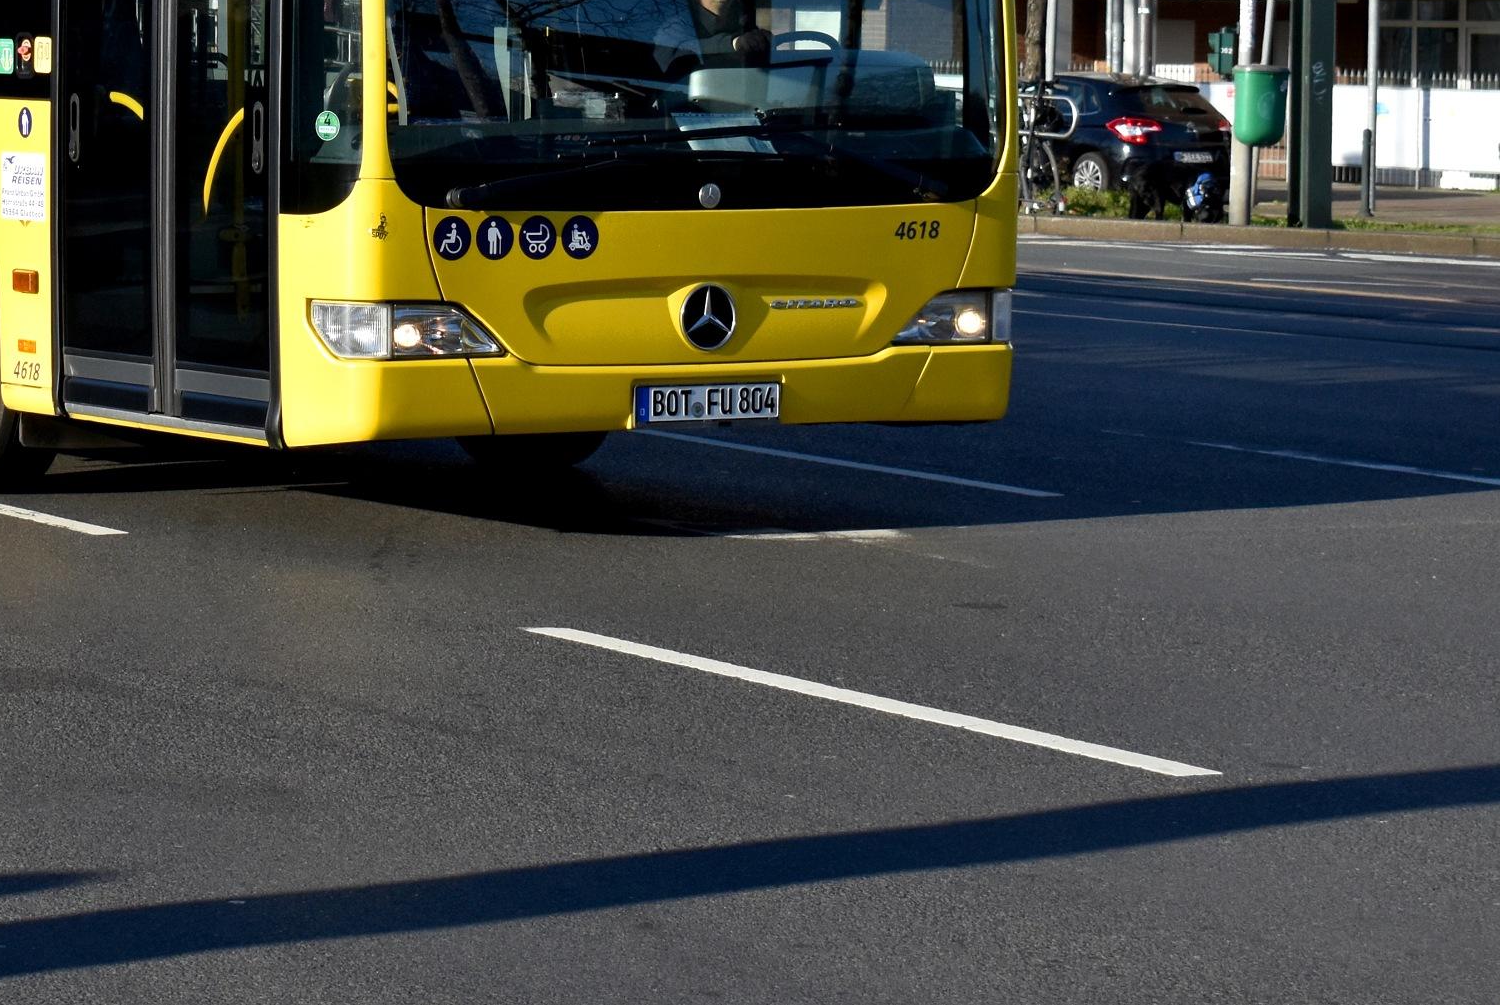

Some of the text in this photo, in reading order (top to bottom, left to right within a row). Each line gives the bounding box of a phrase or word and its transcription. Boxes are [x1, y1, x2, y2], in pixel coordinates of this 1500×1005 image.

[324, 113, 331, 126] 4
[12, 176, 42, 185] REISEN
[895, 220, 940, 240] 4618
[13, 360, 41, 381] 4618
[652, 389, 692, 417] BOT
[706, 388, 732, 415] FU
[738, 387, 775, 414] 804
